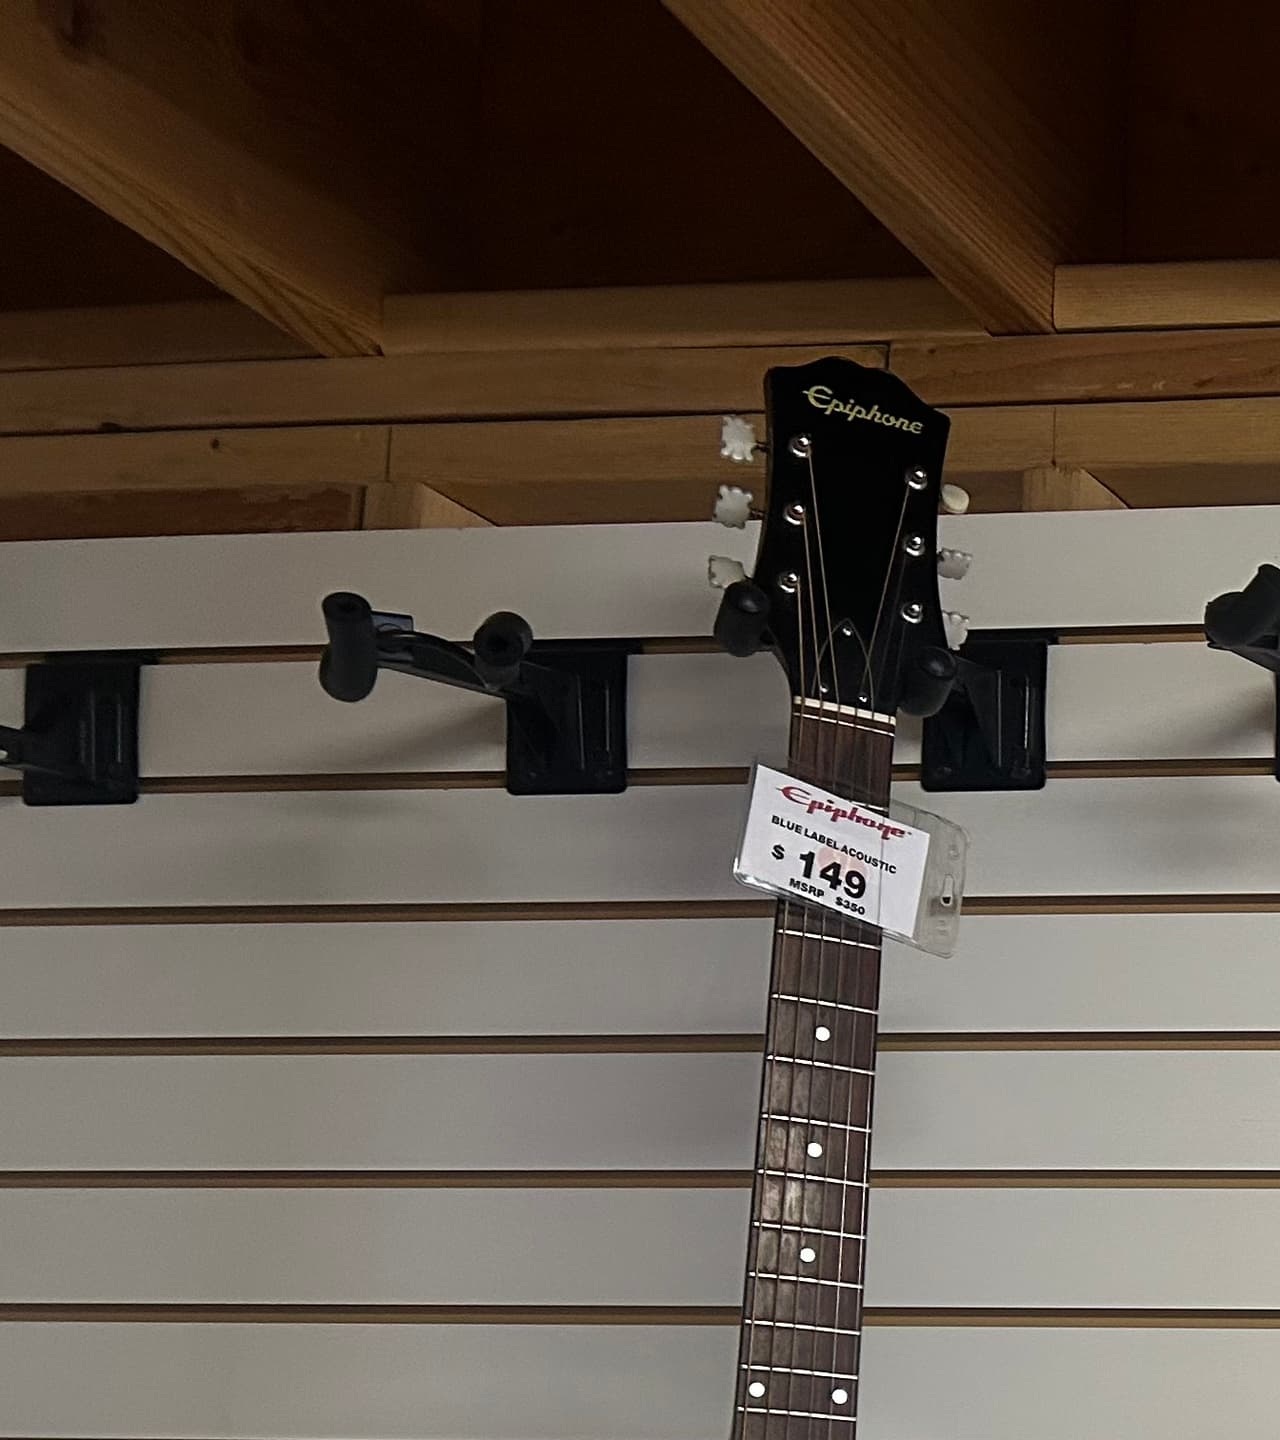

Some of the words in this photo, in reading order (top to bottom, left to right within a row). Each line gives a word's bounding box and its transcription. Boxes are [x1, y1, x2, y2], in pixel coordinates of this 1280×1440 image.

[803, 385, 925, 434] Epiphone
[776, 786, 909, 840] Epiphone
[771, 815, 802, 835] BLUE
[804, 828, 838, 850] LABEL
[840, 845, 897, 874] ACOUSTIC
[771, 844, 785, 860] $
[799, 851, 867, 899] 149
[789, 877, 825, 898] MSRP
[835, 897, 866, 915] $350
